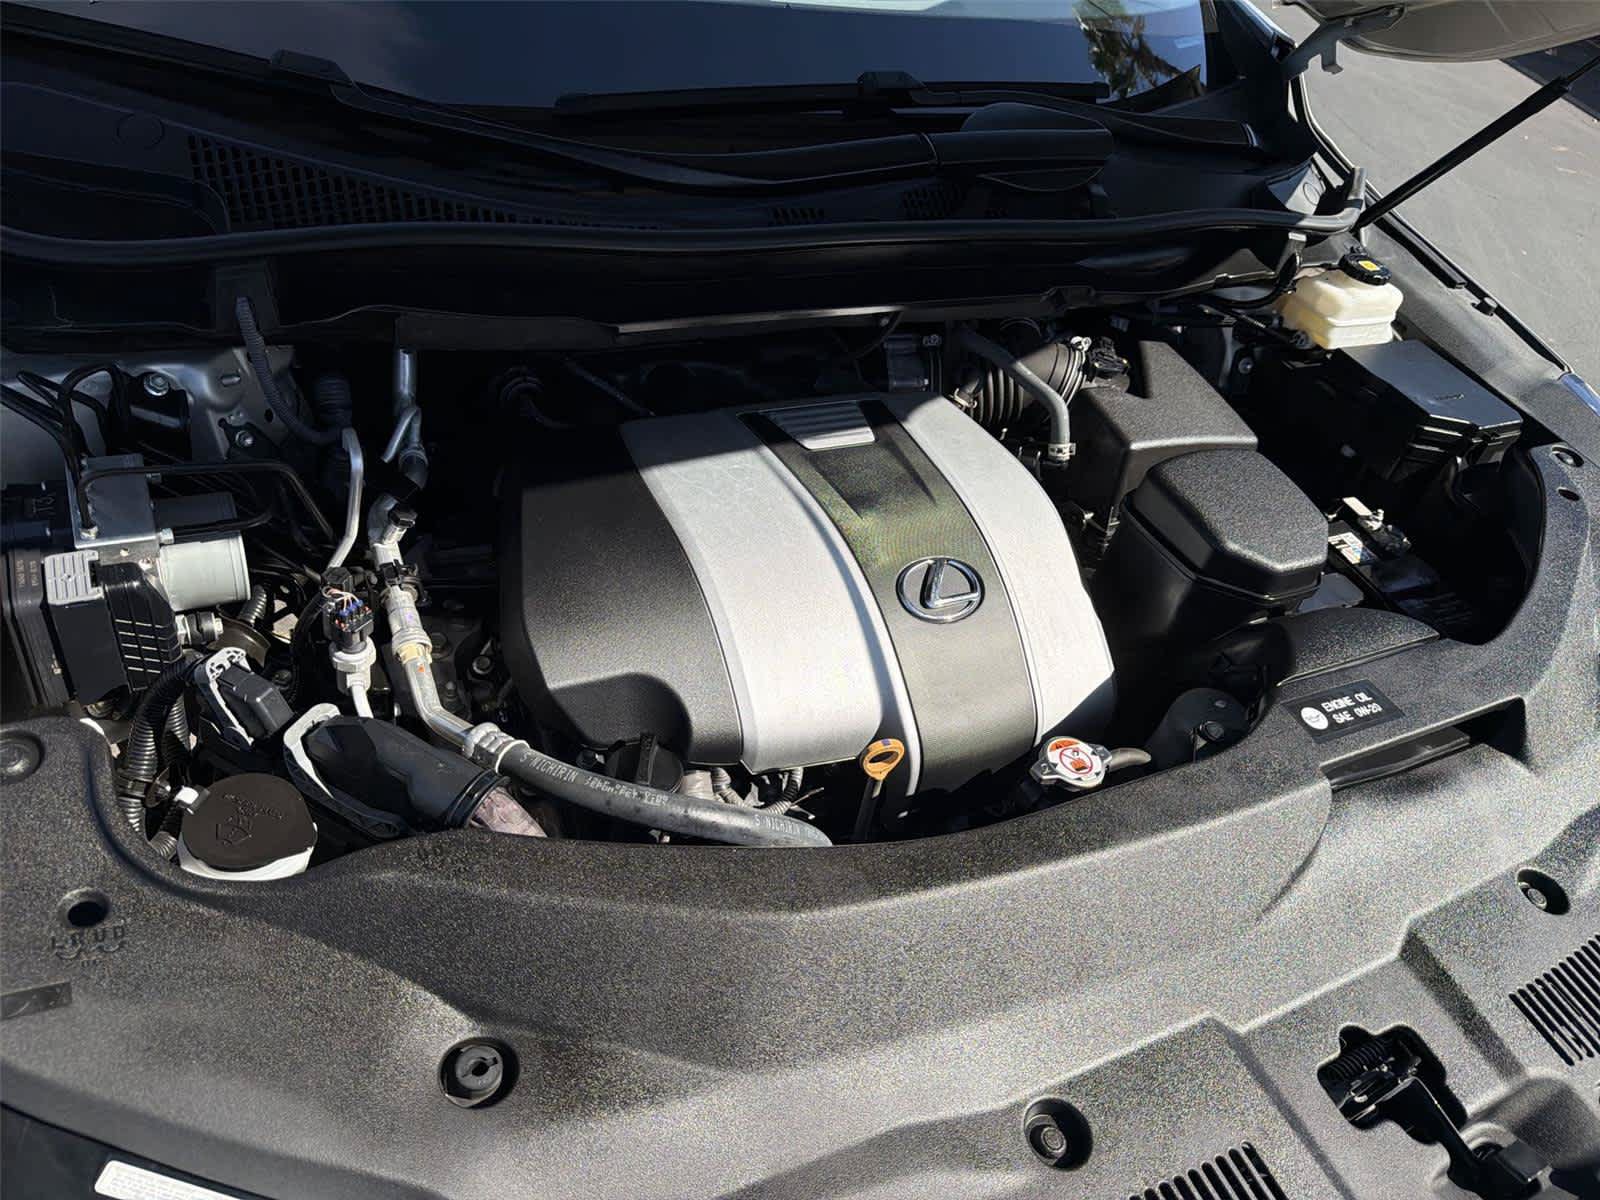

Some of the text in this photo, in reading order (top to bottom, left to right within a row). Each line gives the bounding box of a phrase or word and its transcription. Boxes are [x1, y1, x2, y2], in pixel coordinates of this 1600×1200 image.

[1321, 692, 1373, 713] ENGINE OIL
[1332, 710, 1354, 724] SAE
